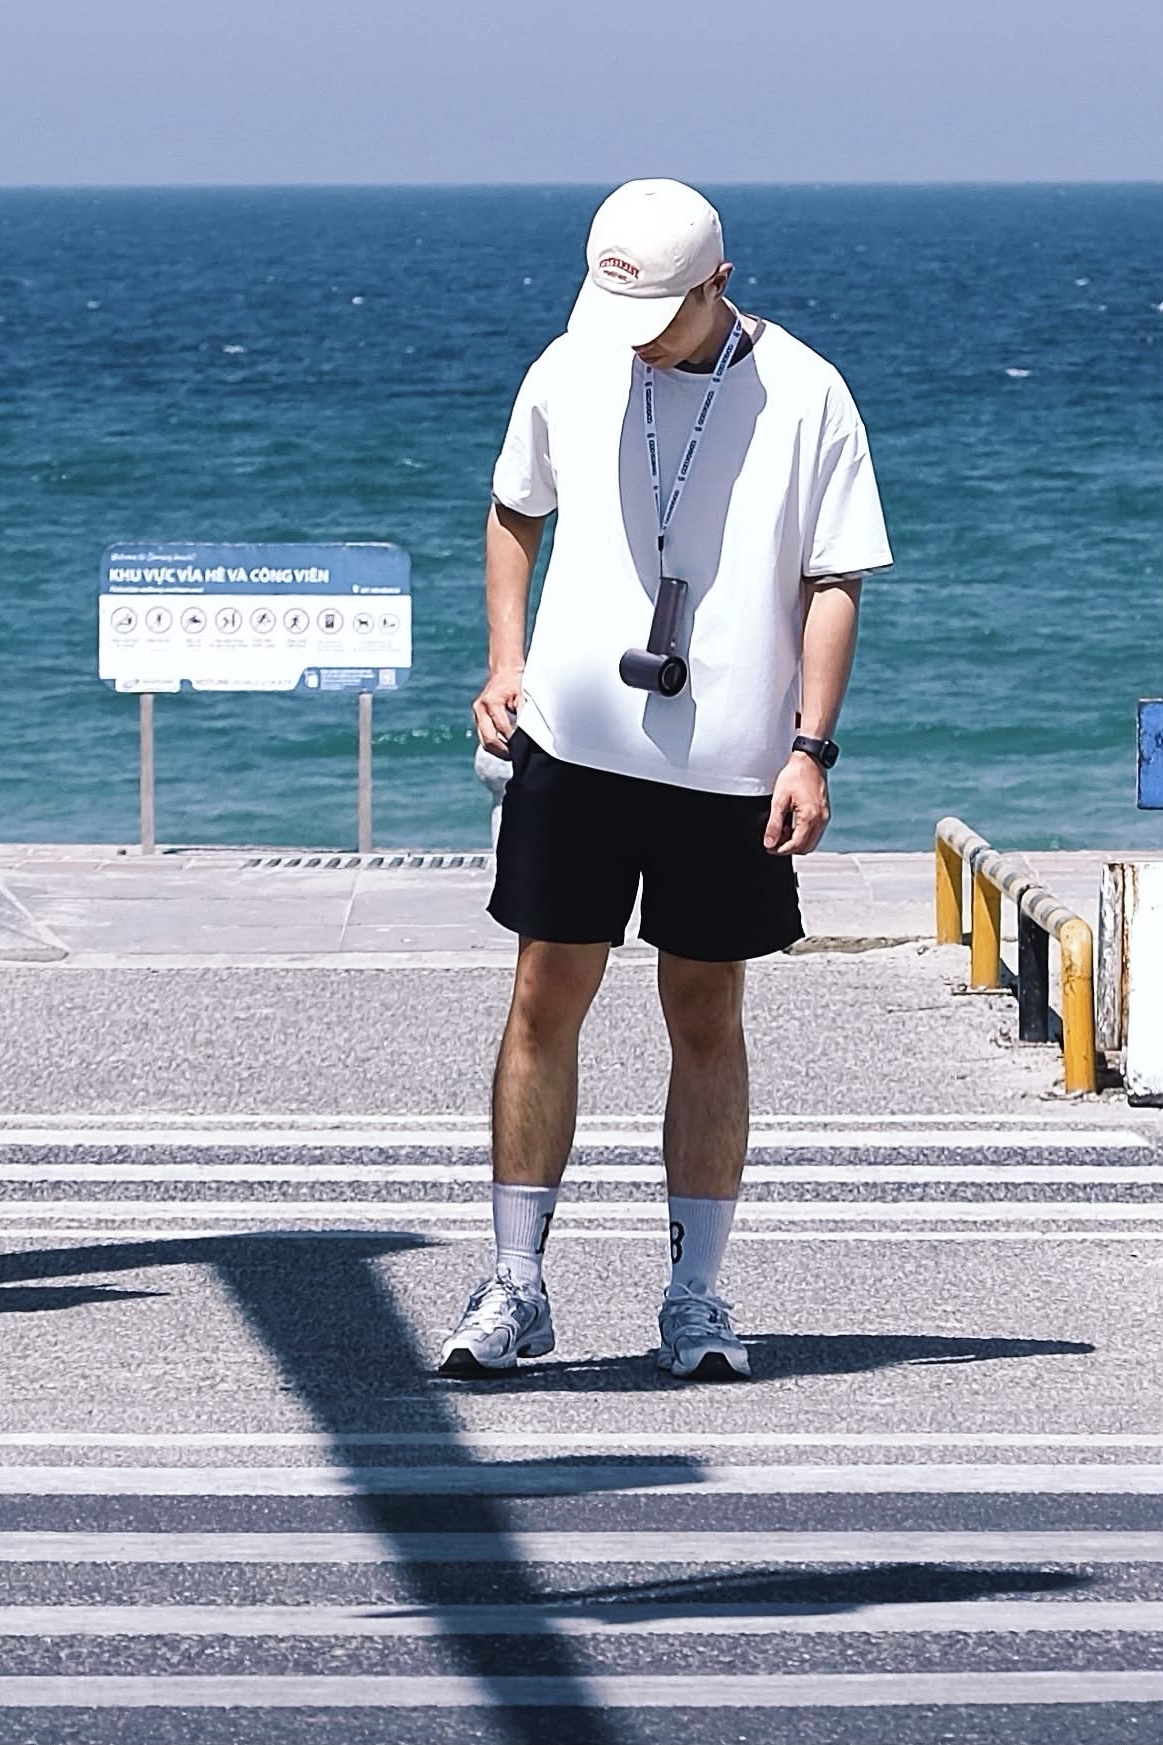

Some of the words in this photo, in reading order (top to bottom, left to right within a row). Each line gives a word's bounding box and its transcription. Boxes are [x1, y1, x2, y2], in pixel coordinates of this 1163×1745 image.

[109, 567, 142, 583] KHU
[249, 565, 293, 584] CÔNG
[294, 565, 330, 584] VIÊN
